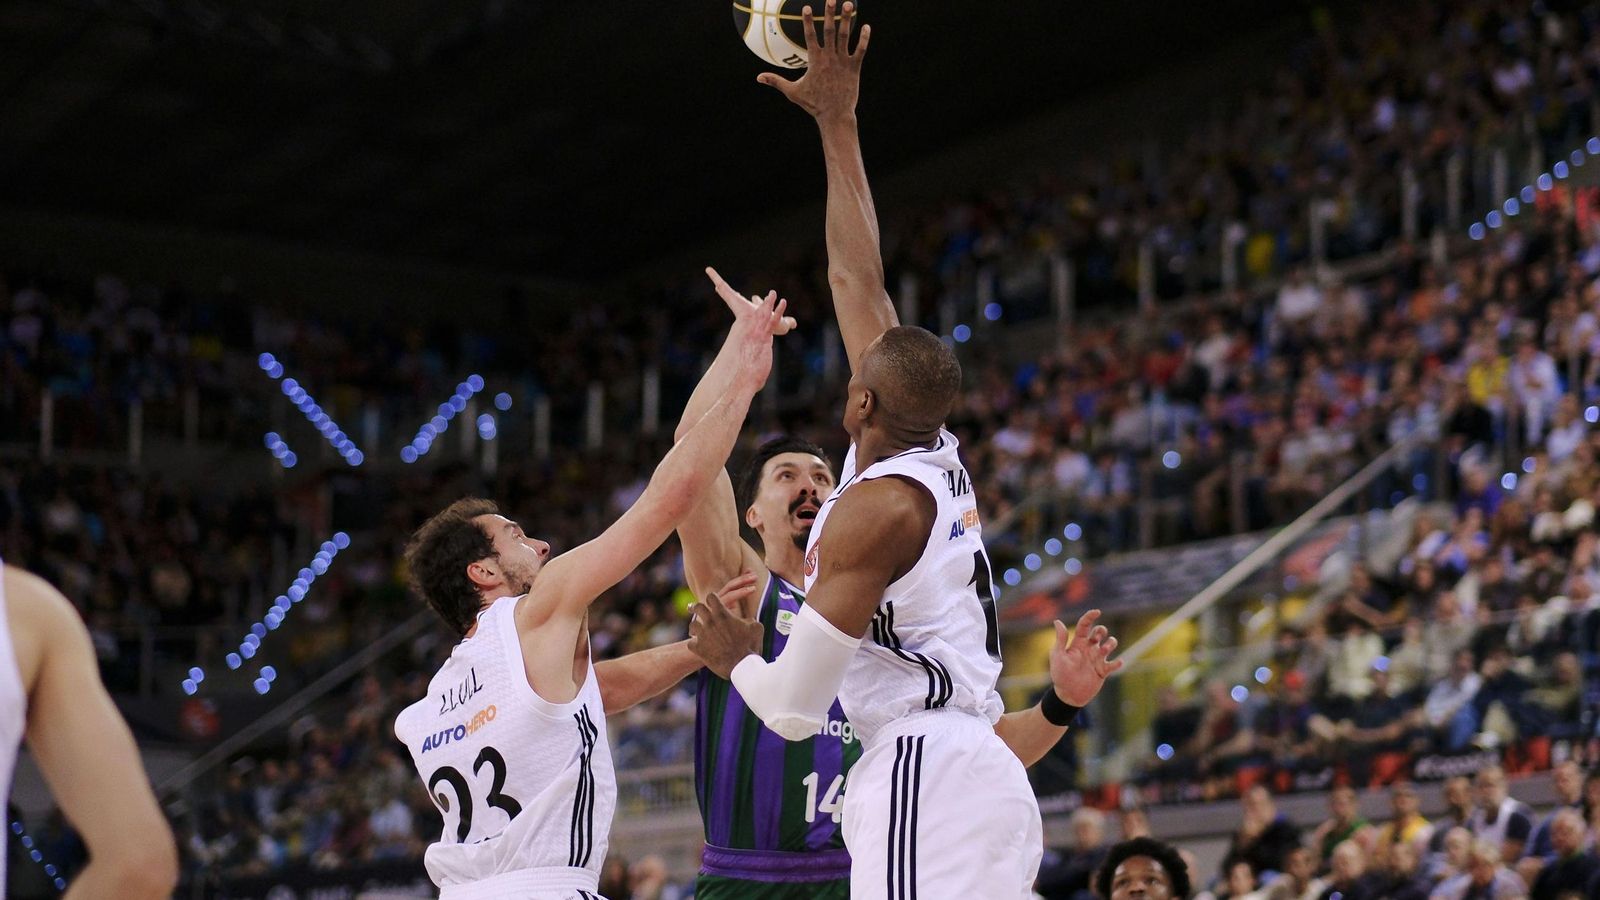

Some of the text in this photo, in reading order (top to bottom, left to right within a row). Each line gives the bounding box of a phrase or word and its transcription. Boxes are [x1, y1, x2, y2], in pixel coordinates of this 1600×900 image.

[421, 705, 497, 754] AUTOHERO
[428, 746, 522, 843] 23
[802, 772, 844, 823] 14
